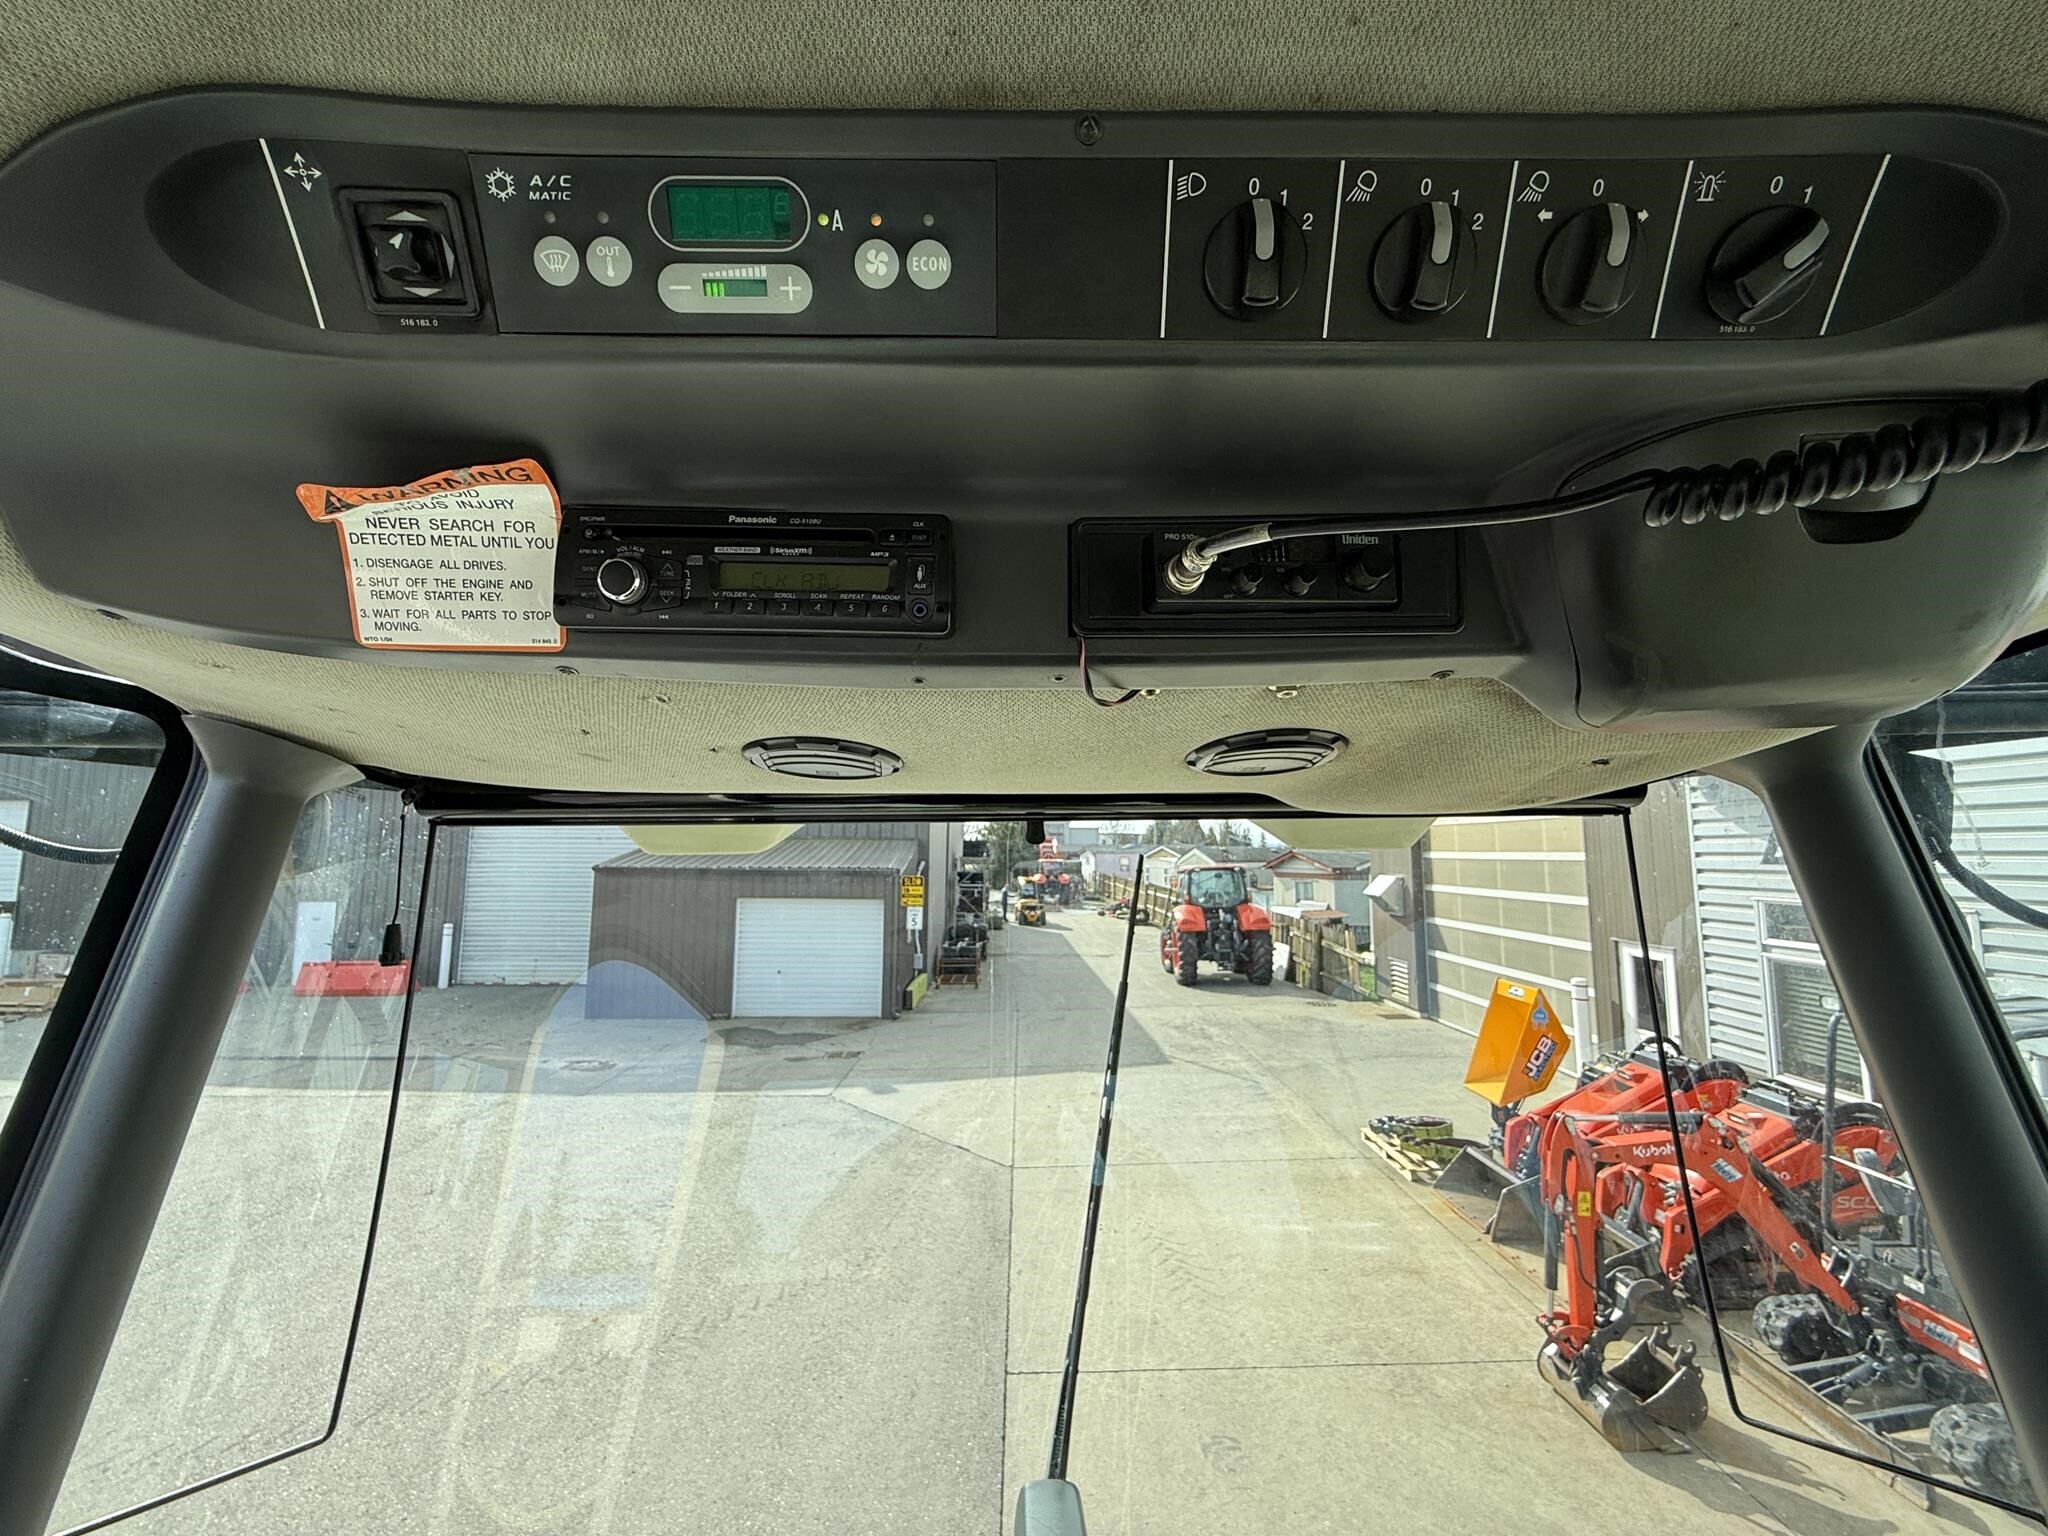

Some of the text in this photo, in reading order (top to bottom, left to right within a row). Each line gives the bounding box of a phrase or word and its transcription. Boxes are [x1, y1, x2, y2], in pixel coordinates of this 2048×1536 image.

[528, 174, 572, 188] A/C
[1248, 177, 1260, 196] 0
[1420, 178, 1432, 196] 0
[1592, 178, 1605, 197] 0
[1769, 175, 1784, 194] 0
[528, 191, 572, 201] MATIC
[1279, 188, 1288, 207] 1
[1451, 189, 1460, 207] 1
[1803, 185, 1814, 205] 1
[831, 208, 844, 232] A
[1301, 212, 1314, 231] 2
[1471, 212, 1484, 231] 2
[596, 245, 620, 257] OUT
[912, 255, 947, 273] ECON
[357, 466, 533, 501] WARNING
[457, 499, 515, 511] INJURY
[365, 517, 536, 533] NEVER SEARCH FOR
[728, 515, 777, 524] Panasonic
[348, 532, 554, 550] DETECTED METAL UNTIL YOU
[1164, 533, 1180, 541] PRO
[1341, 533, 1379, 545] Uniden
[353, 558, 507, 571] 1. DISENGAGE ALL DRIVES.
[356, 577, 533, 590] 2. SHUT OFF THE ENGINE AND
[370, 590, 504, 602] REMOVE STARTER KEY.
[713, 601, 719, 609] 1
[747, 602, 753, 610] 2
[780, 603, 787, 611] 3
[814, 603, 821, 611] 4
[848, 604, 854, 612] 5
[881, 604, 888, 613] 6
[360, 609, 552, 621] 3. WAIT FOR ALL PARTS TO STOP
[374, 621, 422, 632] MOVING.
[1526, 1036, 1553, 1077] JCB
